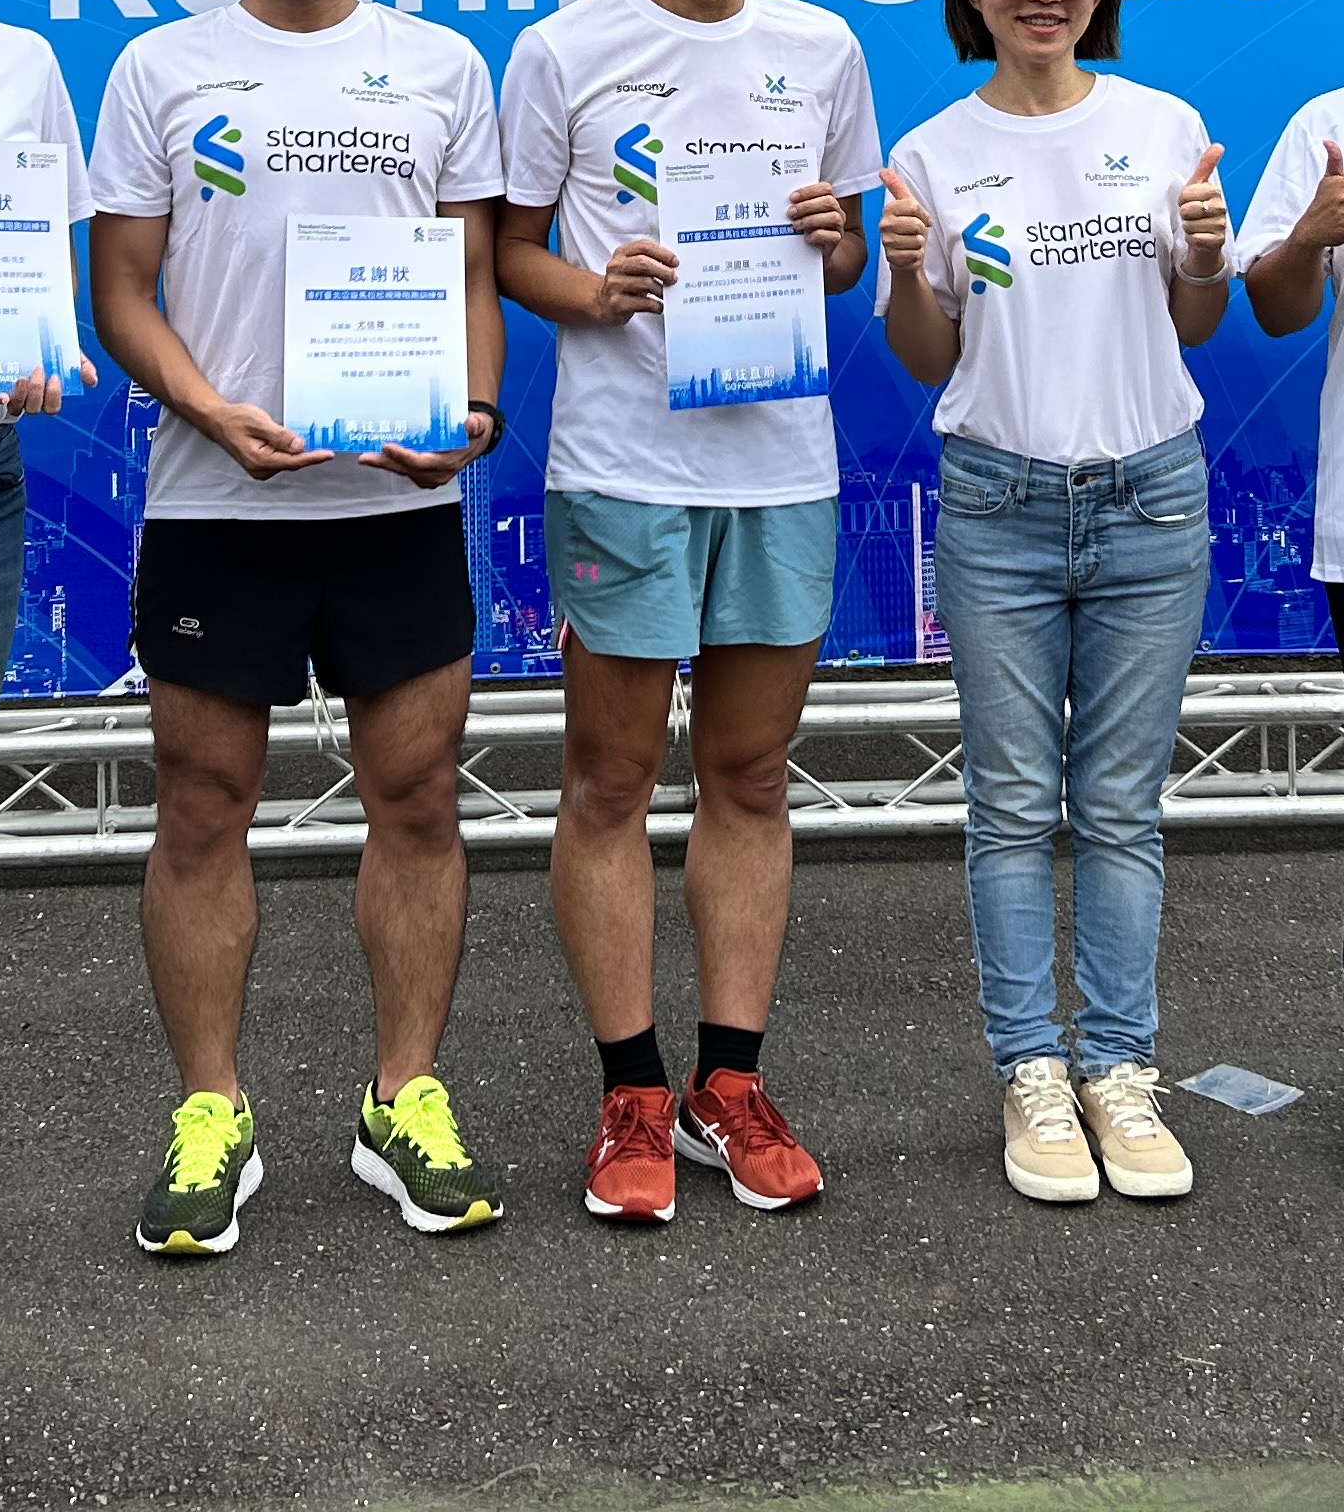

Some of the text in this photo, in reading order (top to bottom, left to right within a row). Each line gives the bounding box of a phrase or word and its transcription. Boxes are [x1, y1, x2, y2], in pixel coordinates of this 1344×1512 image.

[616, 83, 666, 93] saucony
[266, 126, 410, 154] standard
[267, 150, 416, 180] chartered
[954, 174, 1000, 194] saucony
[716, 201, 769, 221] 感謝狀
[1026, 213, 1152, 242] standard
[1030, 237, 1156, 266] chartered
